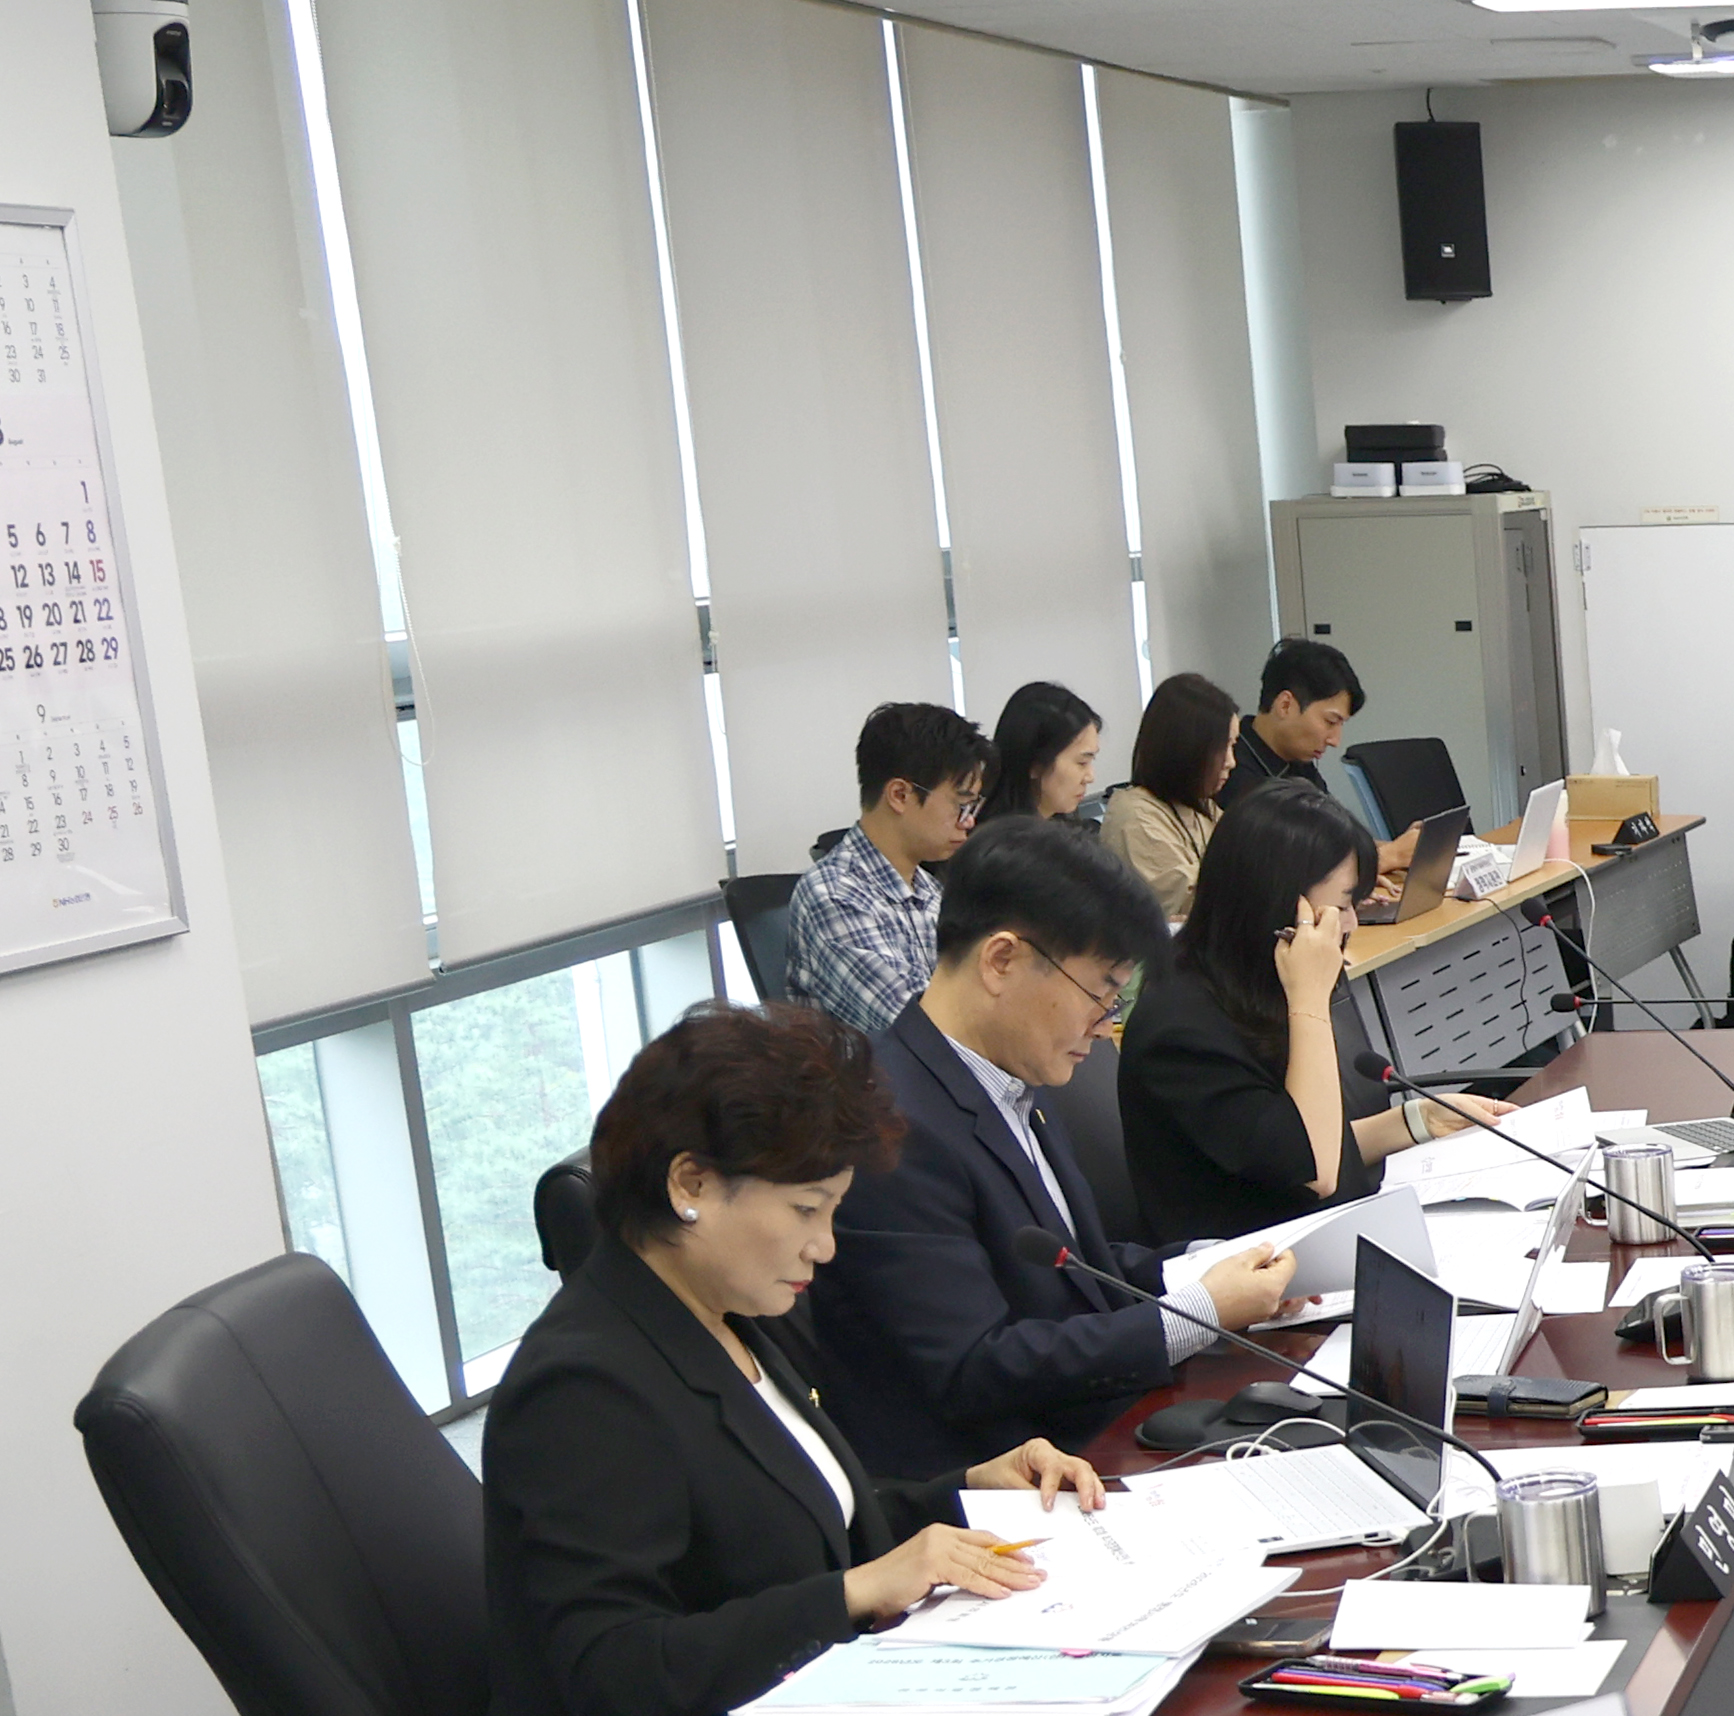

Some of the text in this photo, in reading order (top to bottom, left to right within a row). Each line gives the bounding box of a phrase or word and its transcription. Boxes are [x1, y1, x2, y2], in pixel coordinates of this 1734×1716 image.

[81, 480, 89, 504] 1
[7, 520, 97, 548] 5 6 7 8
[11, 559, 106, 589] 12 13 14 15
[16, 605, 33, 629] 19
[42, 602, 62, 627] 20
[70, 600, 86, 624] 21
[94, 597, 114, 622] 22
[23, 644, 44, 669] 26
[50, 642, 68, 666] 27
[76, 638, 96, 663] 28
[101, 636, 119, 661] 29
[36, 704, 46, 723] 9
[19, 736, 130, 764] 1 2 3 4 5
